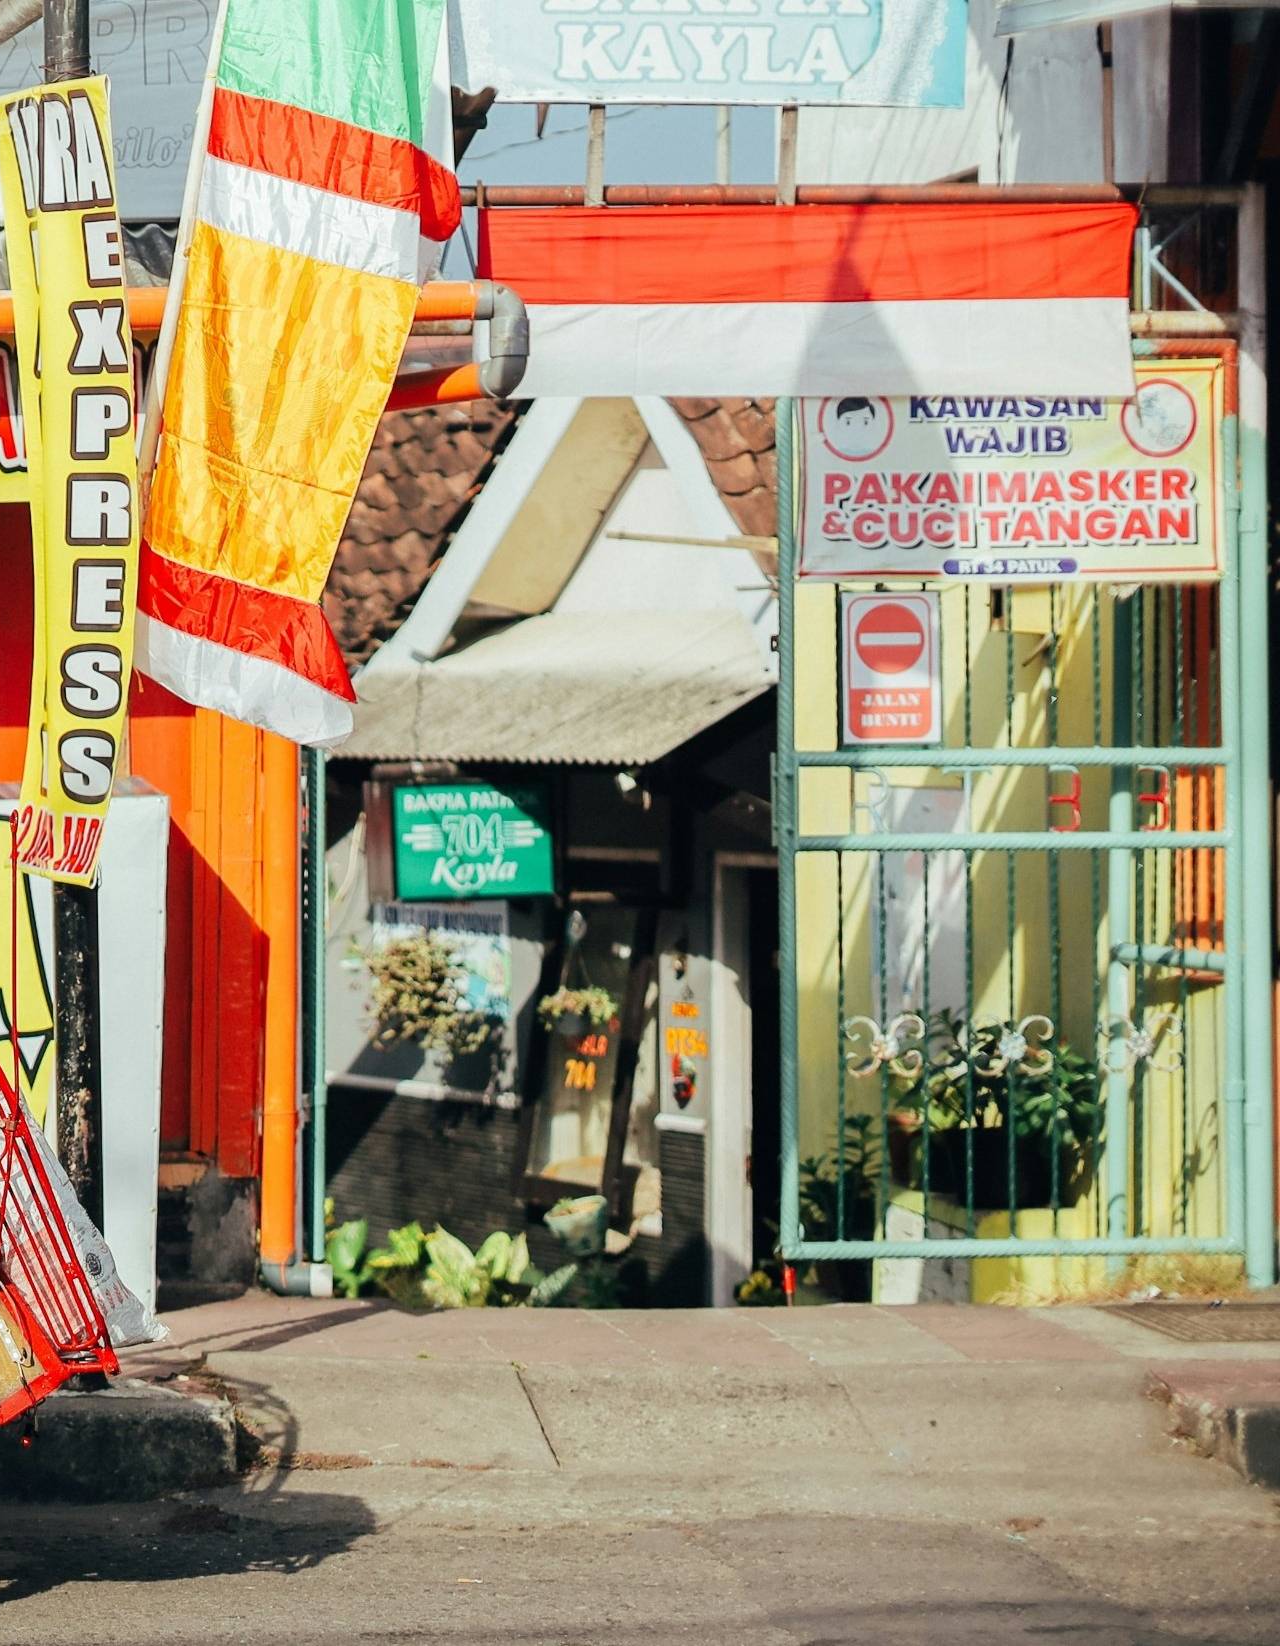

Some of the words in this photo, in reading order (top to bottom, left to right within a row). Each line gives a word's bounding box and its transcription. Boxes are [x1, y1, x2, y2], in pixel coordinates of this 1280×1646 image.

[556, 22, 856, 85] KAYLA
[908, 395, 1104, 420] KAWASAN
[944, 425, 1070, 454] WAJIB
[823, 472, 975, 505] PAKAI
[985, 469, 1190, 503] MASKER
[57, 212, 130, 804] EXPRESS
[981, 507, 1192, 541] TANGAN
[861, 692, 921, 707] JALAN
[860, 713, 922, 727] BUNTU
[441, 812, 505, 857] 704
[430, 854, 519, 893] Kayla
